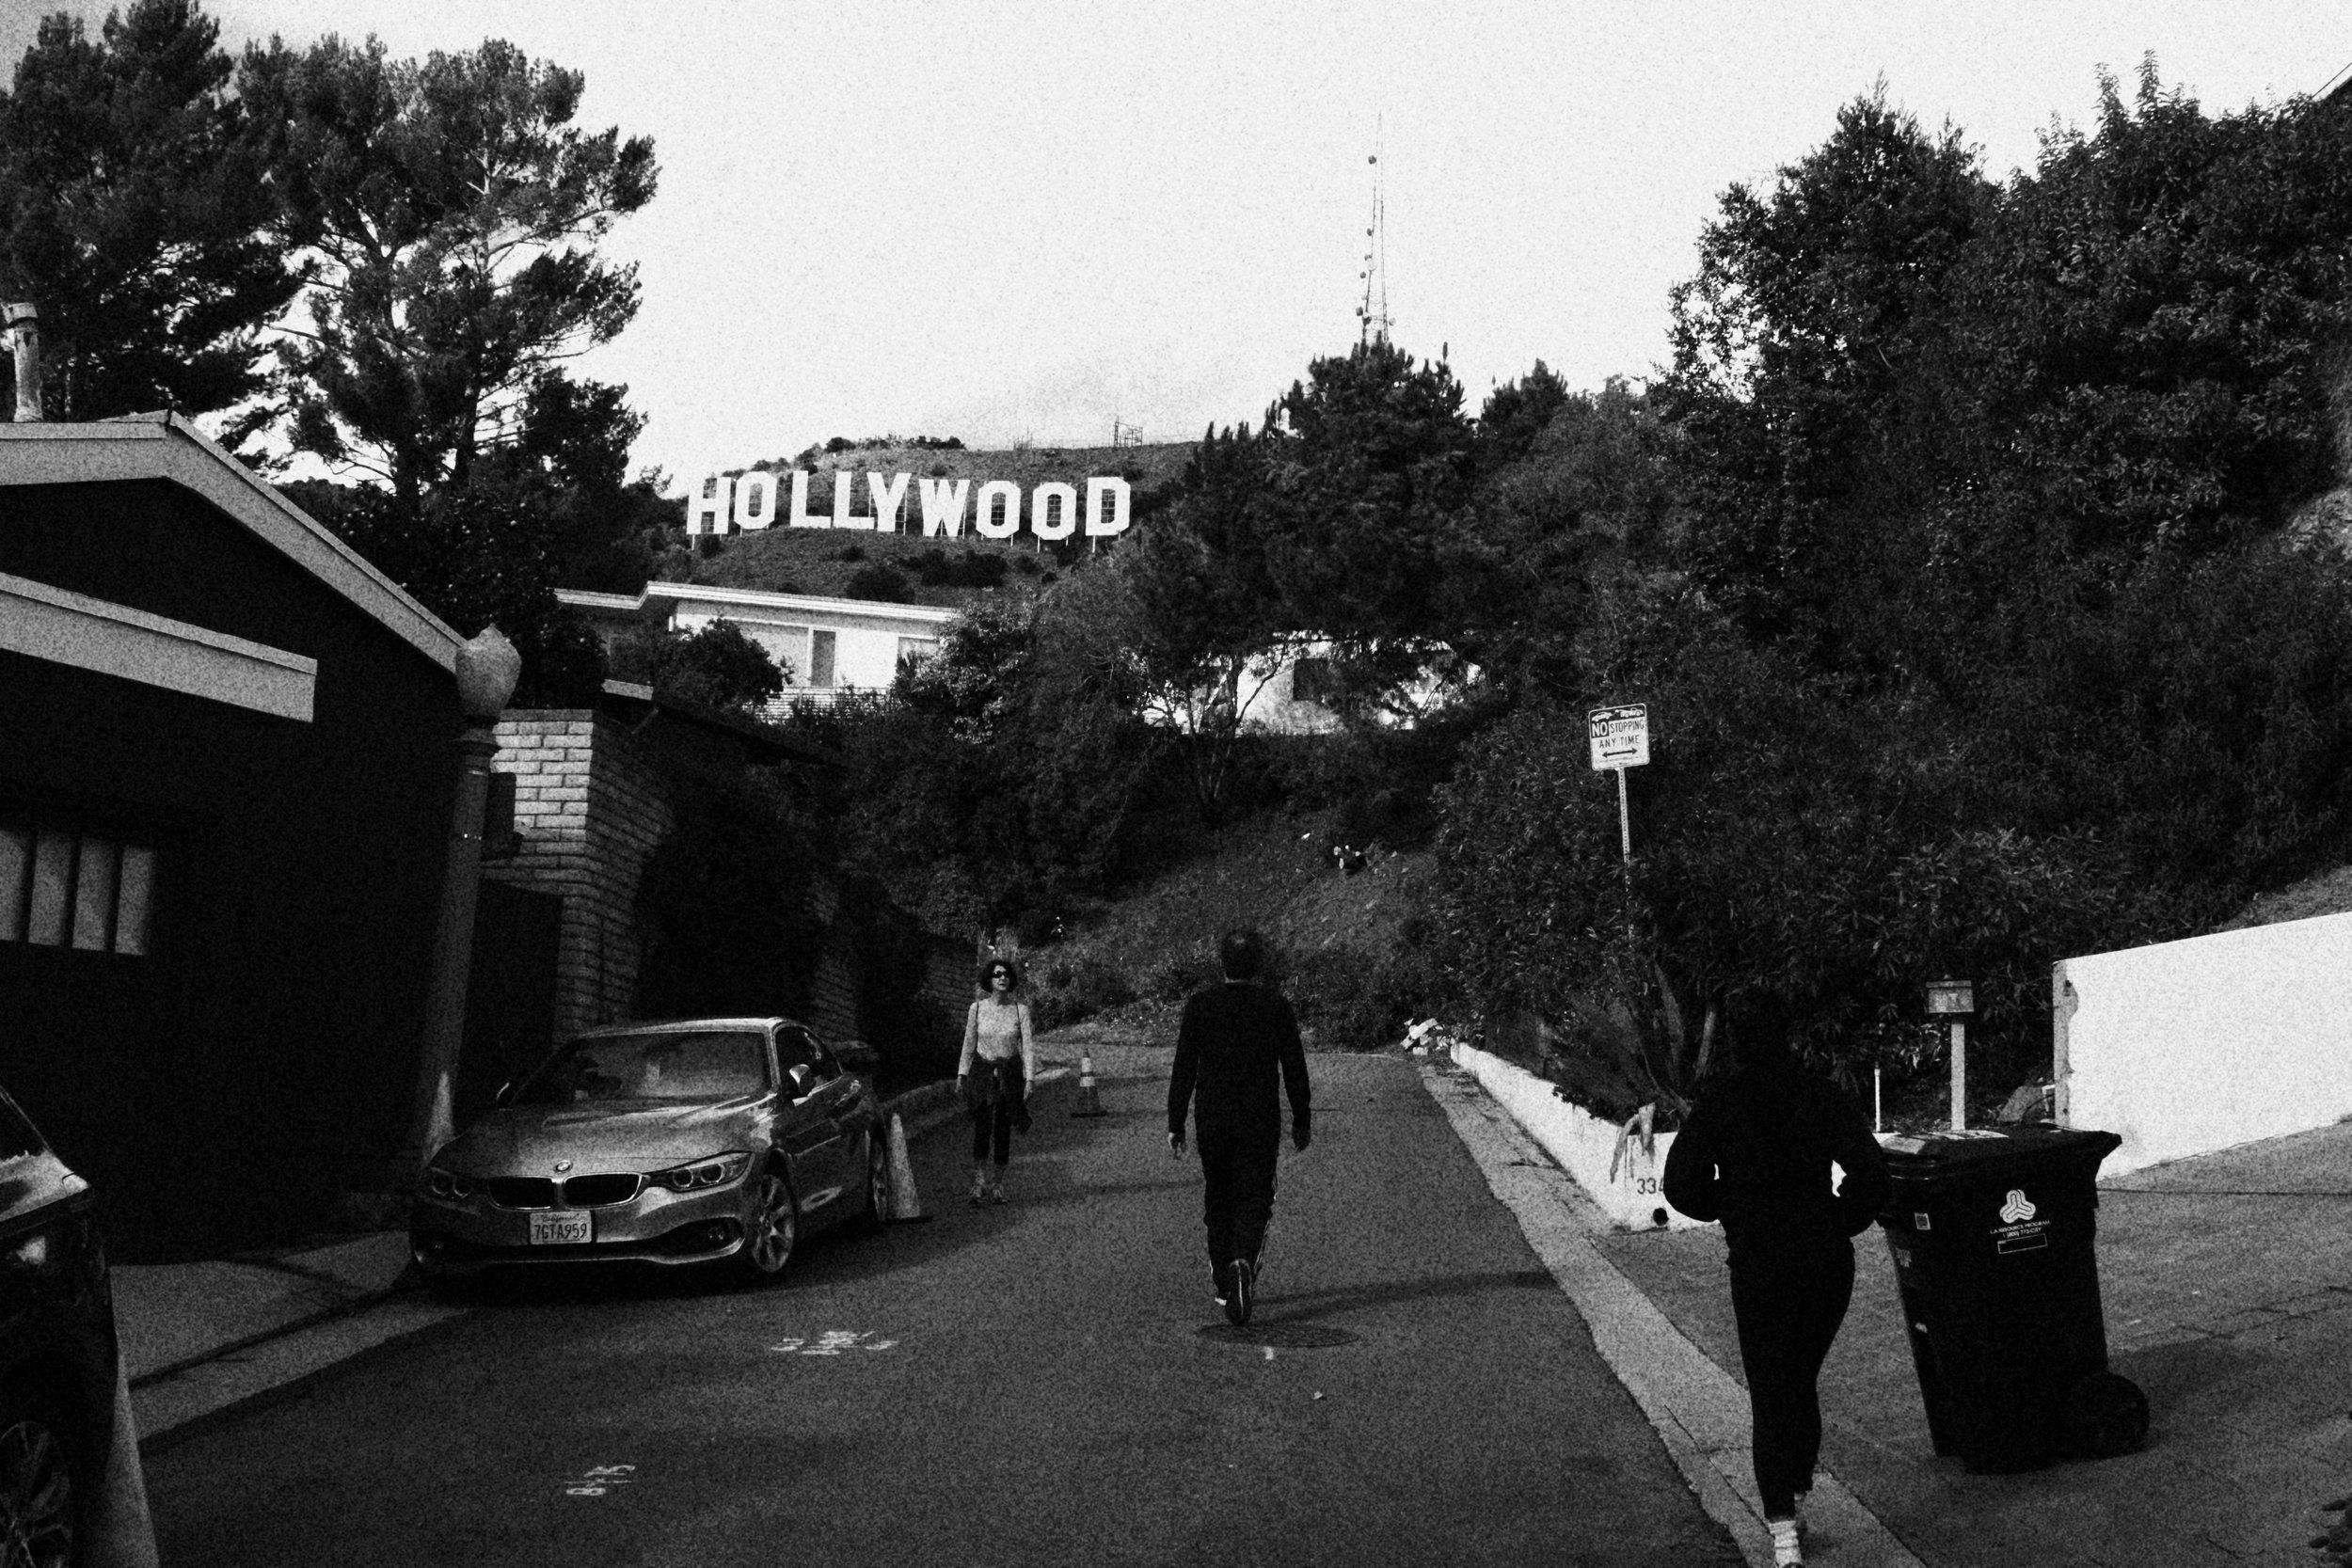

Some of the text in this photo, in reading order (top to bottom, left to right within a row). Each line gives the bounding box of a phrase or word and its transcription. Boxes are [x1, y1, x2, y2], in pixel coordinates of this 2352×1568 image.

[686, 470, 1131, 540] HOLLYWOOD
[1591, 720, 1645, 737] NO STOPPING
[1599, 735, 1640, 749] ANY TIME
[533, 1223, 587, 1240] 7GTA959
